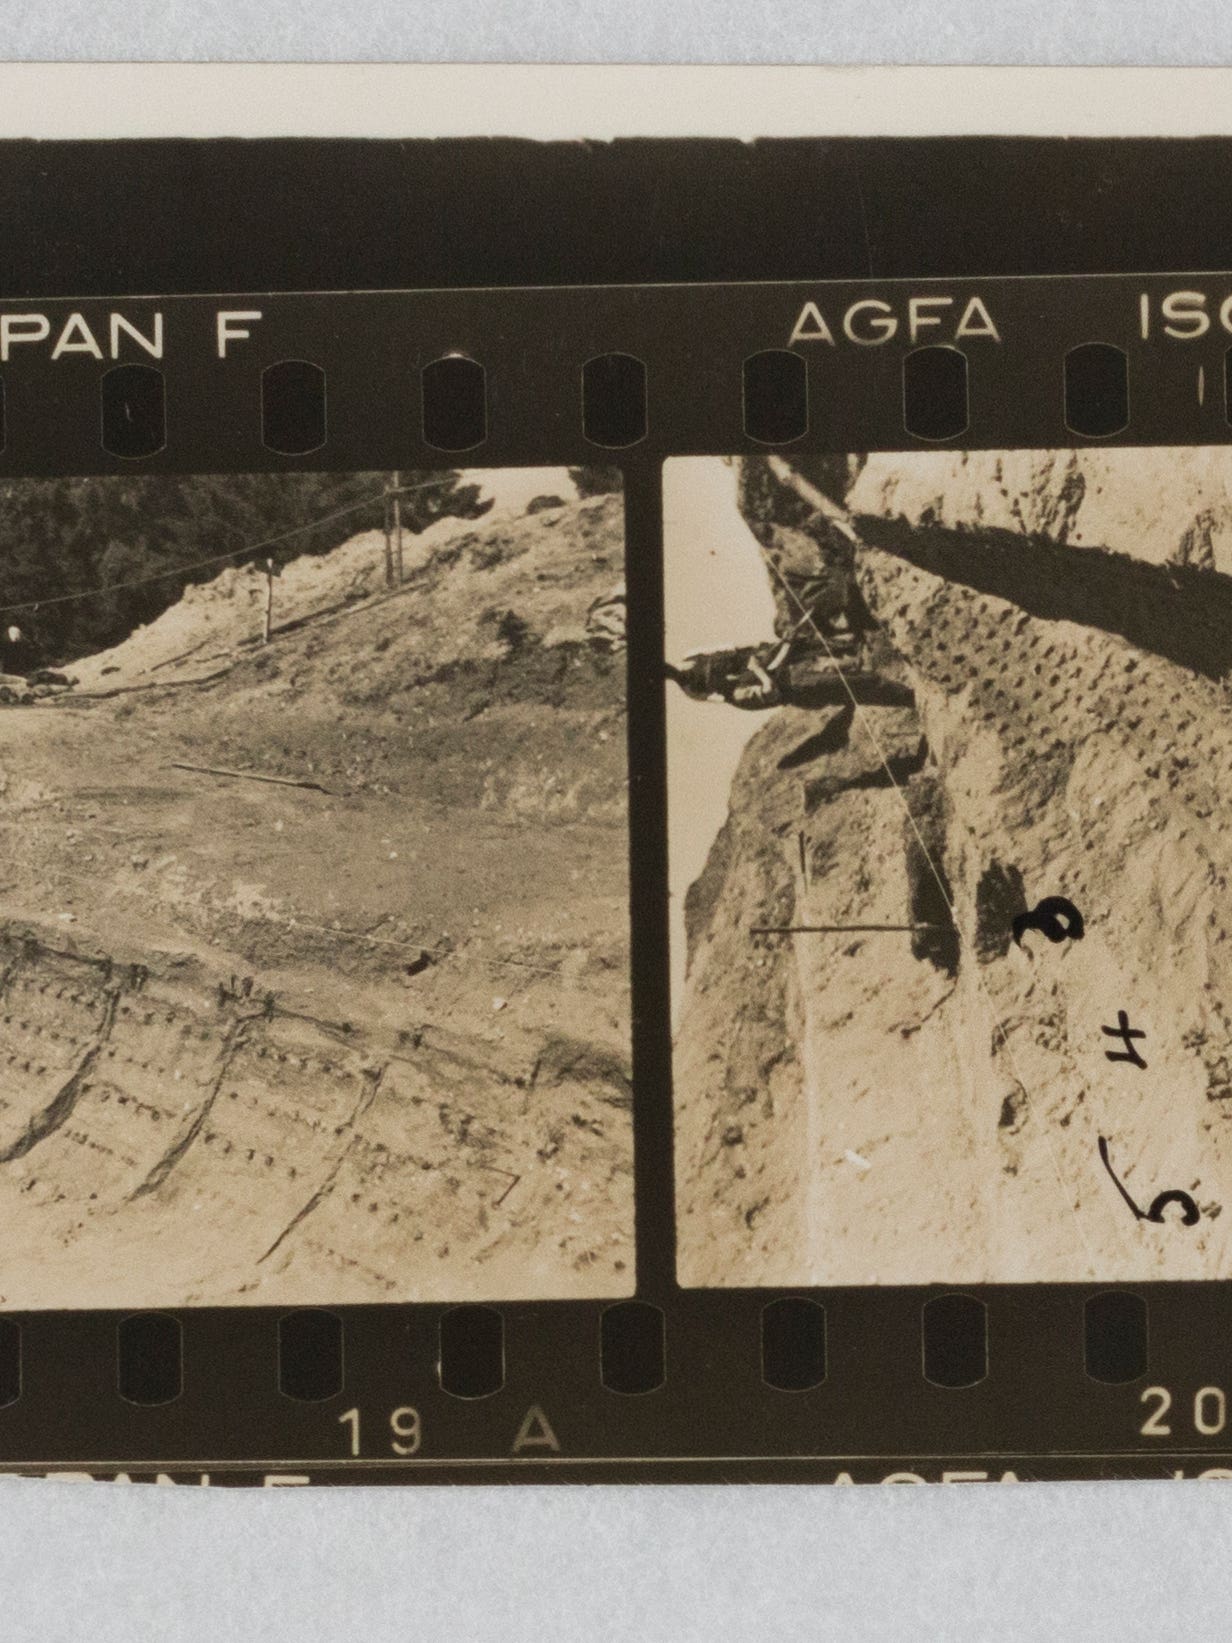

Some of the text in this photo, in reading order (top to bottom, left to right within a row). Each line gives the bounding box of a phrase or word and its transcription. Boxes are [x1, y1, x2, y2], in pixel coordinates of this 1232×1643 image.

[0, 310, 263, 362] PAN F
[788, 296, 1001, 347] AGFA
[338, 1406, 561, 1457] 19 A
[1139, 1385, 1227, 1436] 20
